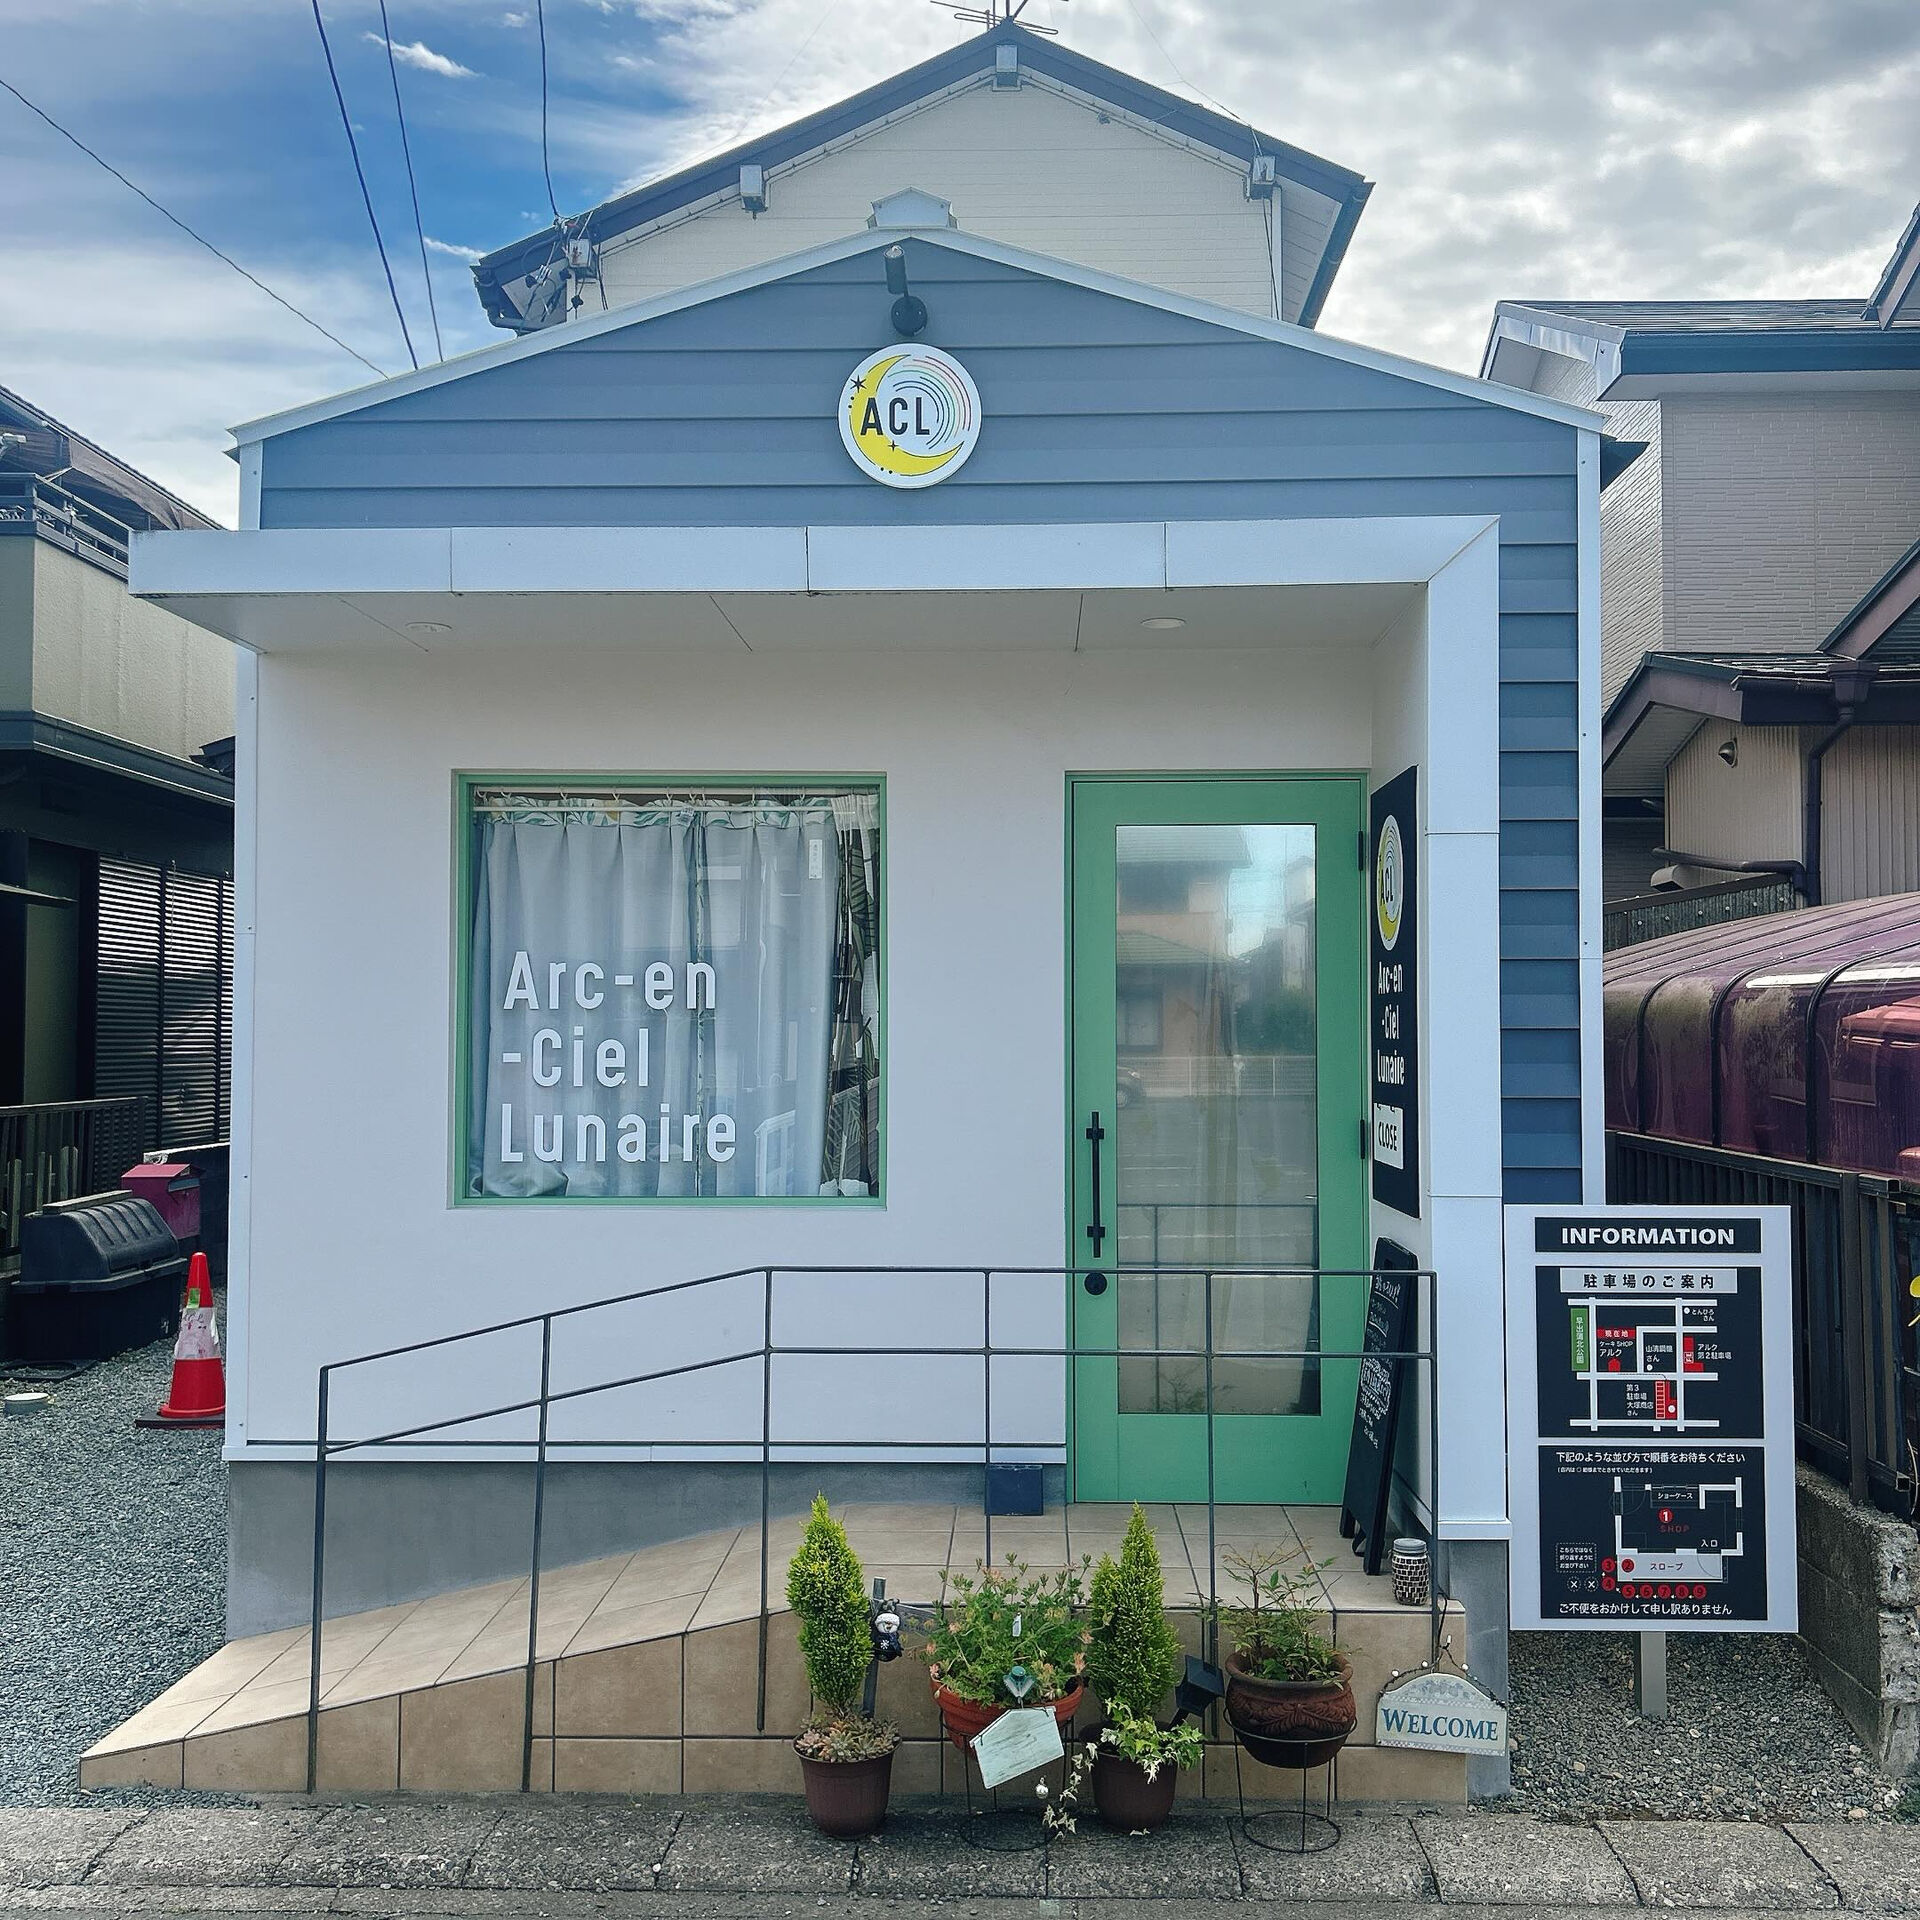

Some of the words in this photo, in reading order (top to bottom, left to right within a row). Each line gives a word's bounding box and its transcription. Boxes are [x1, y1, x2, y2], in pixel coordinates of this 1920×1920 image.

[860, 397, 930, 436] ACL
[503, 951, 716, 1010] Arc-en
[1378, 961, 1403, 995] Arc-en
[1381, 1004, 1400, 1040] -Ciel
[502, 1026, 649, 1087] -Ciel
[1377, 1049, 1405, 1086] Lunaire
[500, 1103, 736, 1163] Lunaire
[1378, 1121, 1398, 1151] CLOSE
[1561, 1227, 1735, 1245] INFORMATION
[1583, 1274, 1715, 1289] 駐車場のご案内
[1604, 1329, 1629, 1338] 現在地
[1599, 1348, 1622, 1357] アルク
[1697, 1343, 1718, 1351] アルク
[1646, 1354, 1660, 1363] さん
[1556, 1452, 1746, 1463] 下記のような並び方で順番をお待ちください
[1657, 1492, 1694, 1500] ショーケース
[1700, 1539, 1718, 1547] 入口
[1650, 1563, 1683, 1571] スロープ
[1559, 1603, 1732, 1615] ご不便をおかけして申し訳ありません
[1381, 1708, 1498, 1741] WELCOME
